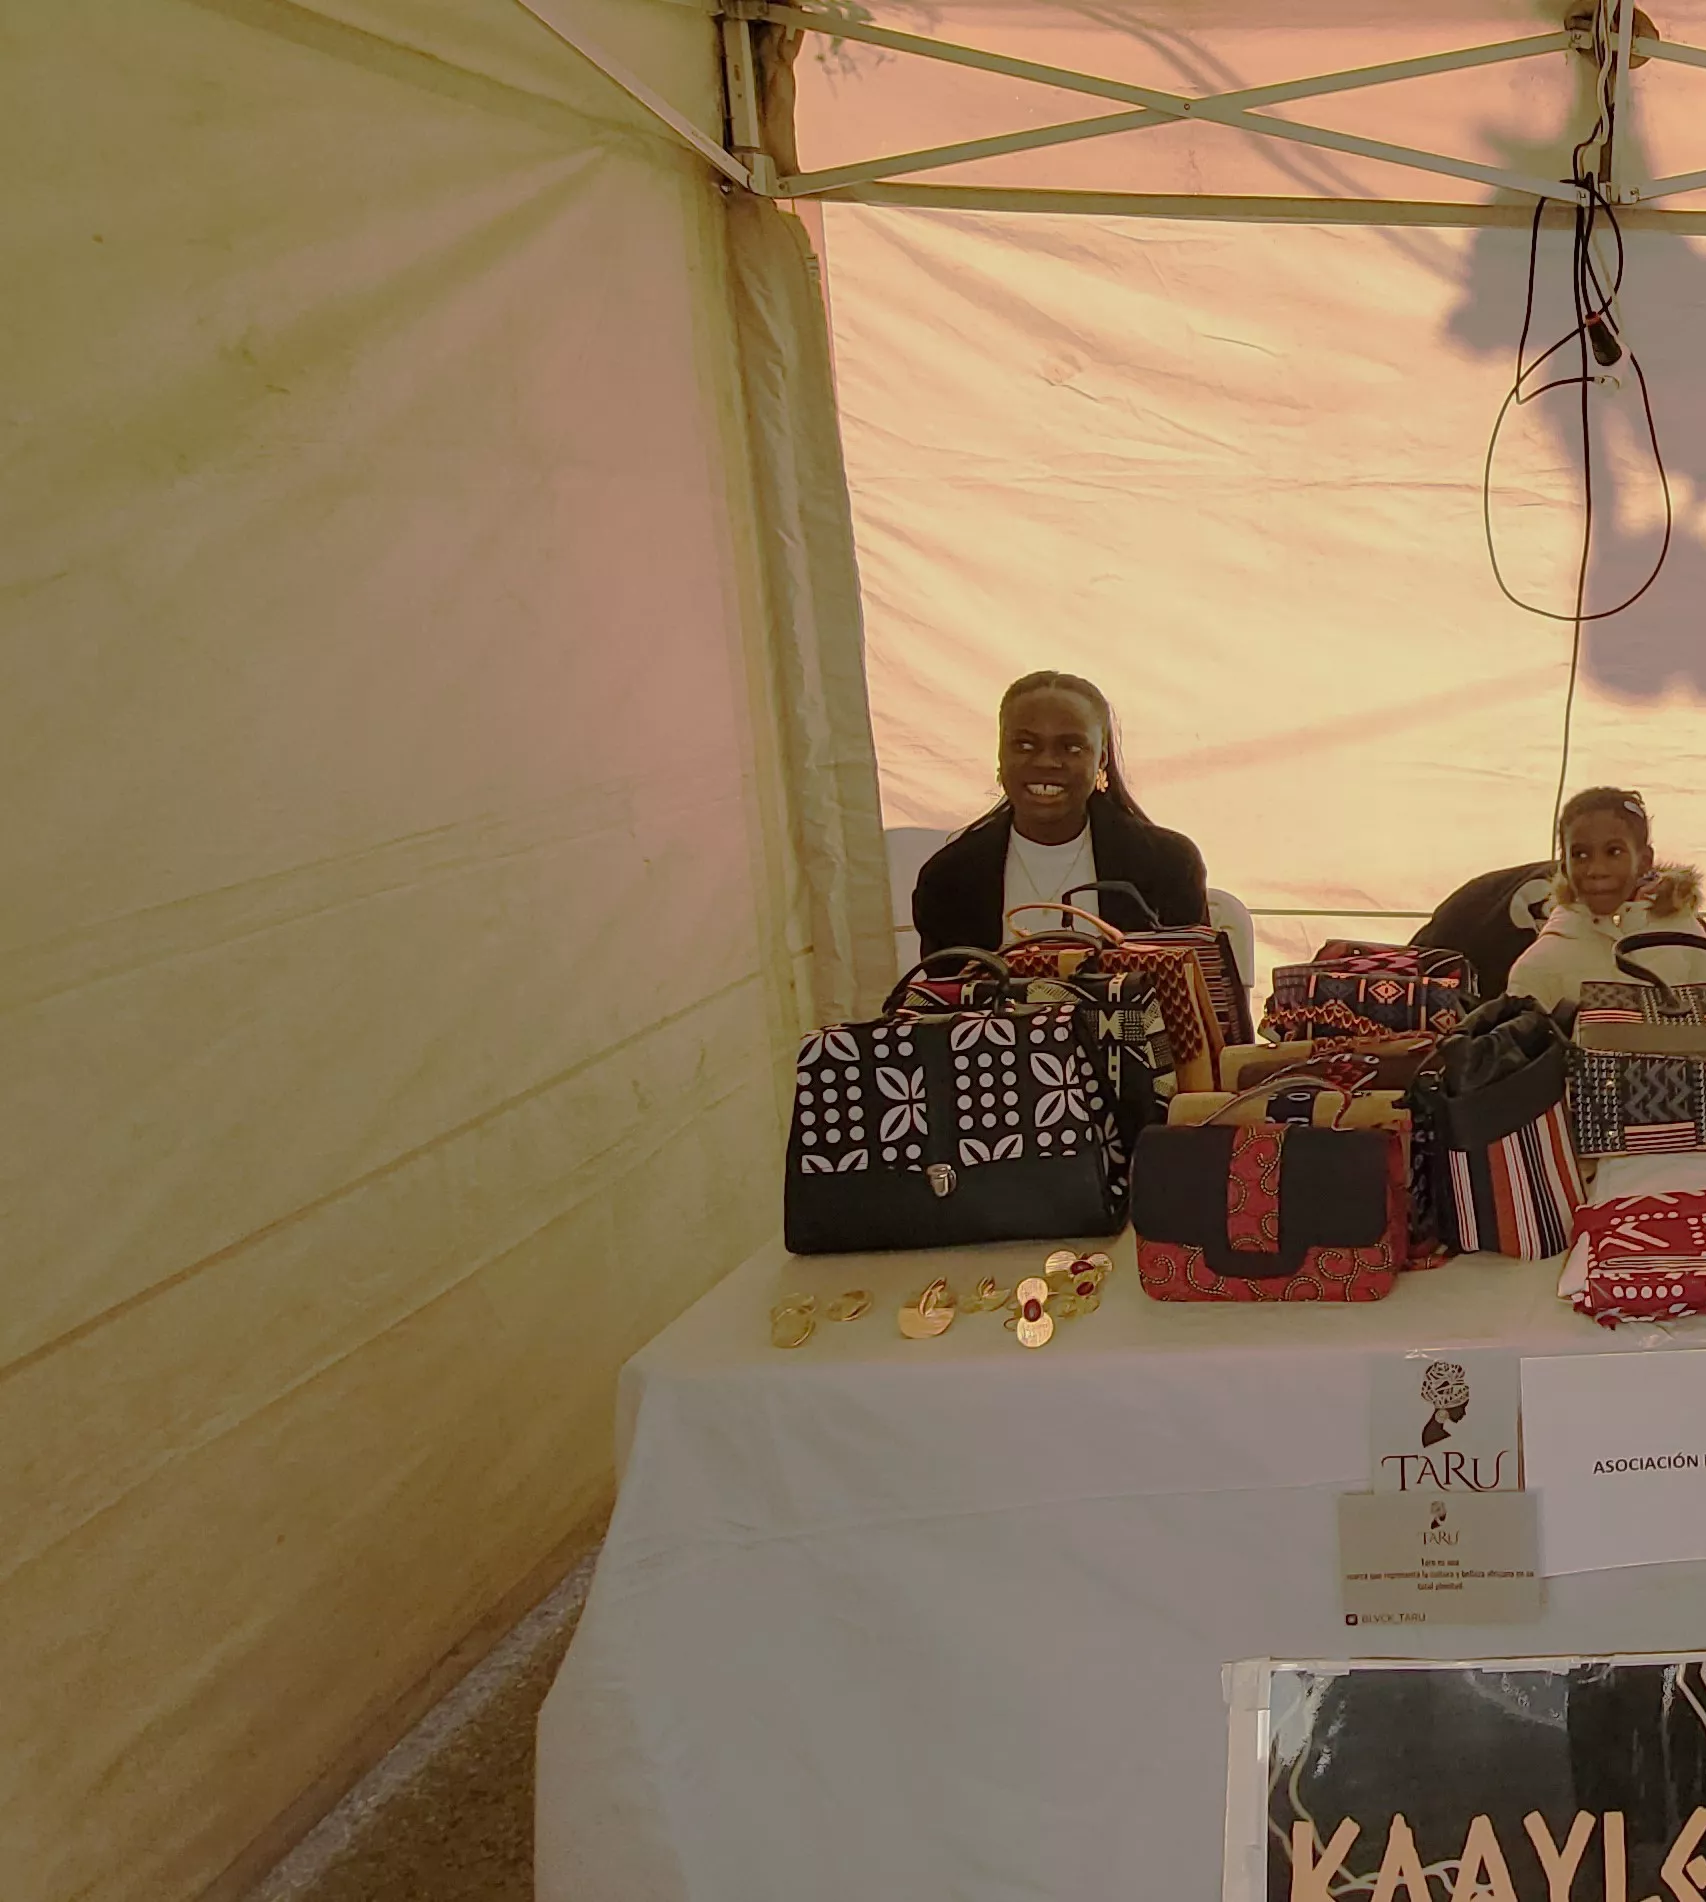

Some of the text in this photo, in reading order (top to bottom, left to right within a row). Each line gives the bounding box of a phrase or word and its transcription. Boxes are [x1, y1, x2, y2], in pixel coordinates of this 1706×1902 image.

[1381, 1450, 1510, 1493] TARU
[1593, 1452, 1699, 1475] ASOCIACIÓN
[1417, 1530, 1460, 1546] TARU
